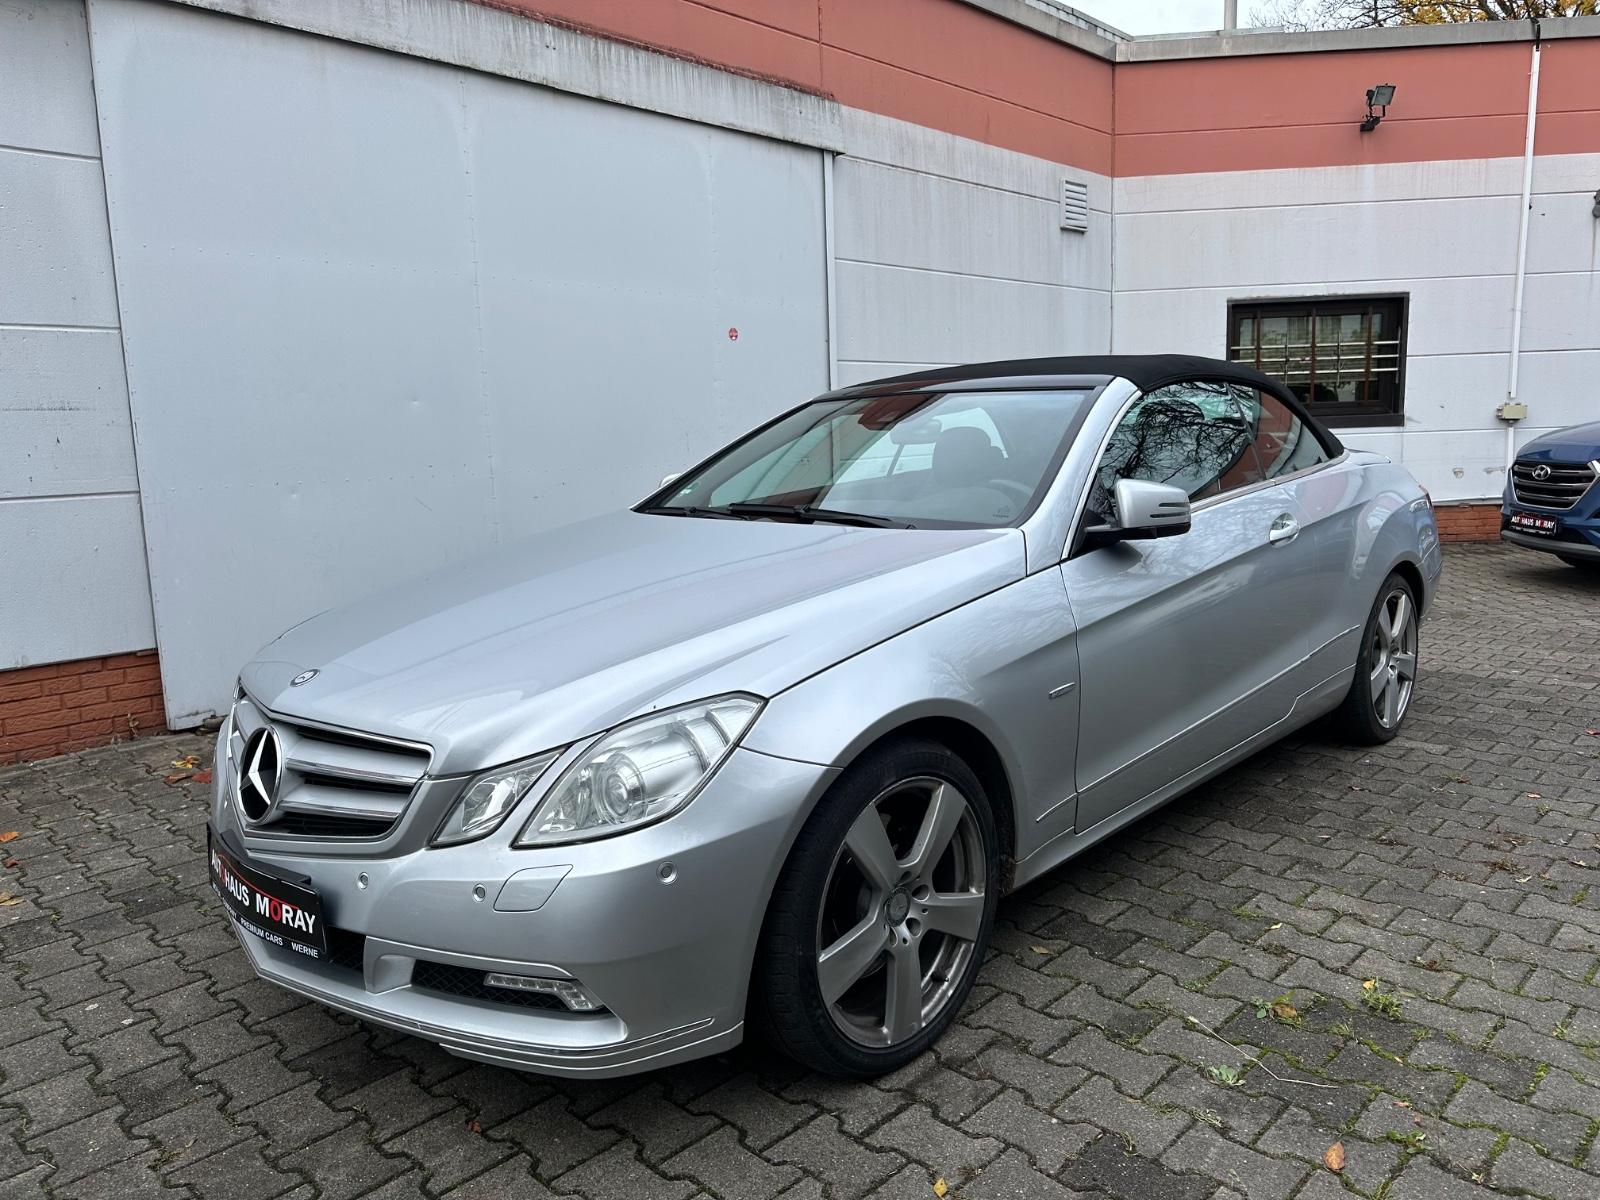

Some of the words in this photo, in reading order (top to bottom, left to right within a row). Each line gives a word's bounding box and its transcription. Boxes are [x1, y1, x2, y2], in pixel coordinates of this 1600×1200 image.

[211, 848, 250, 907] AUTOHAUS
[255, 892, 316, 934] MORAY
[240, 917, 265, 939] PREMIUM
[265, 932, 284, 947] CARS
[291, 941, 319, 959] WERNE
